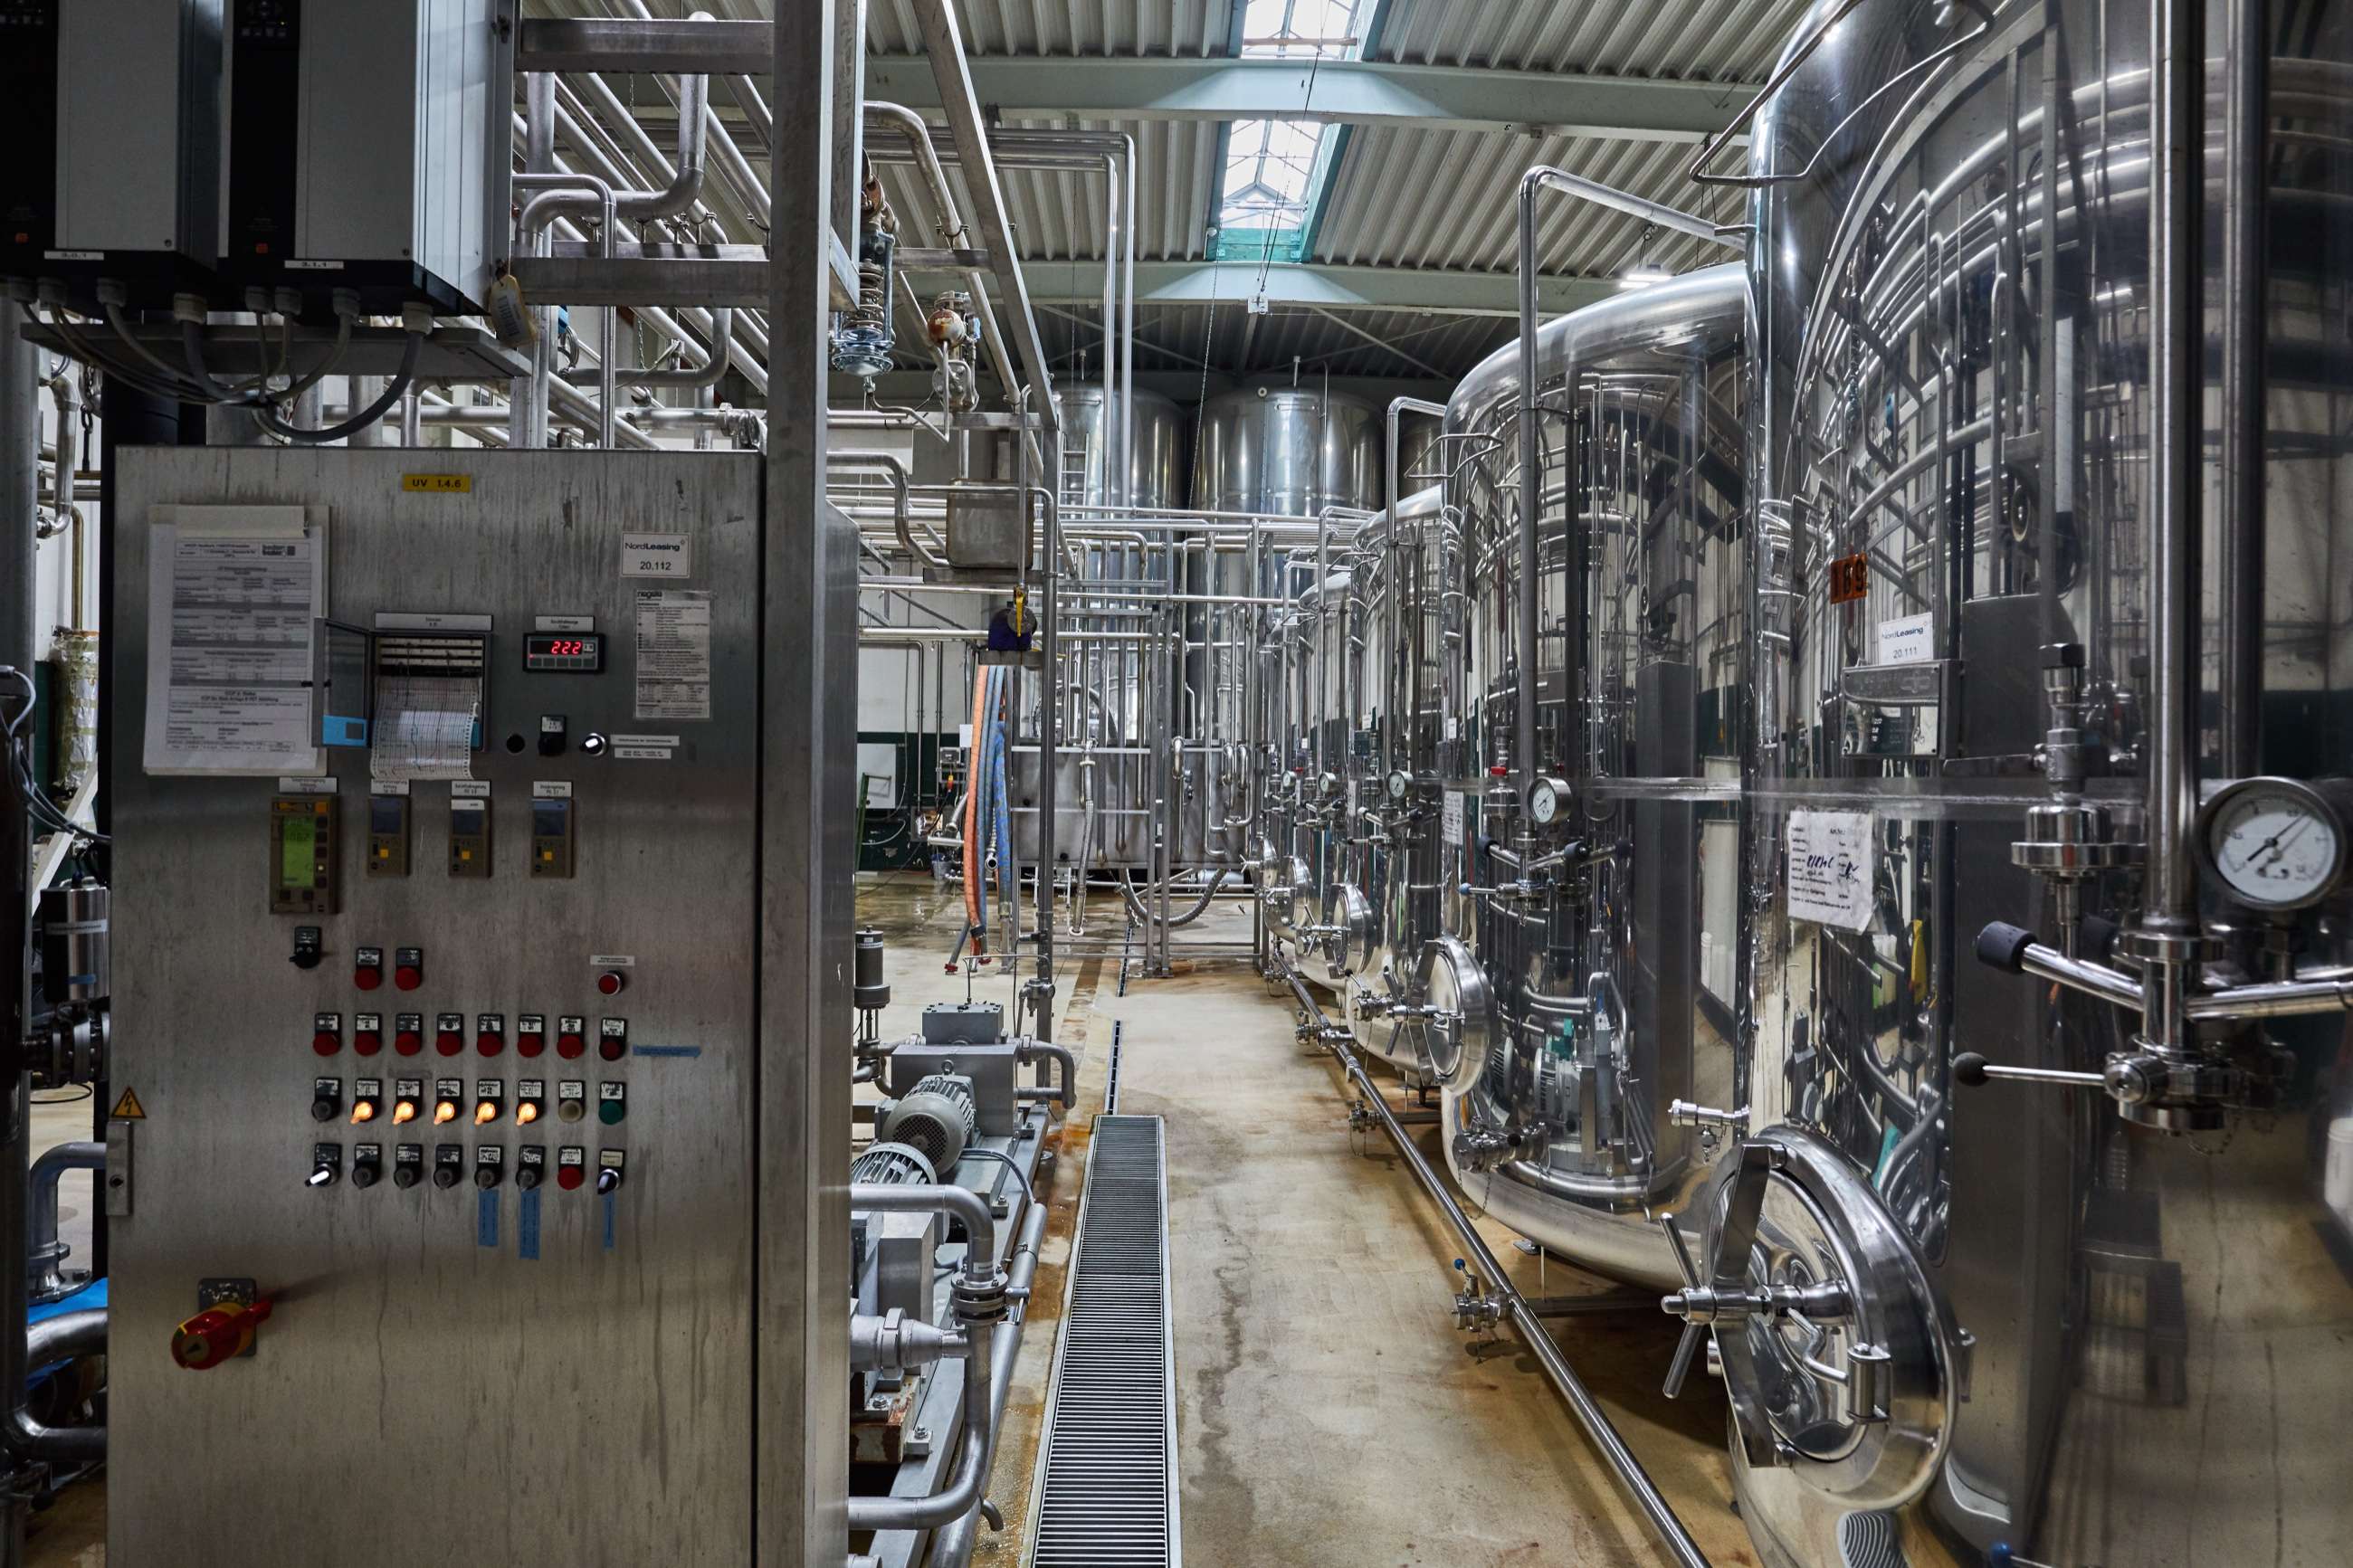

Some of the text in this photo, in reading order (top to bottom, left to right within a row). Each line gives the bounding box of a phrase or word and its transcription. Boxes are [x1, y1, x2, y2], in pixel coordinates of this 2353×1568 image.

[412, 479, 428, 487] UV
[624, 542, 681, 552] NordLeasing
[640, 561, 672, 571] 20.112
[1881, 626, 1924, 640] NordLeasing
[550, 641, 582, 655] 222
[1892, 646, 1918, 659] 20.111
